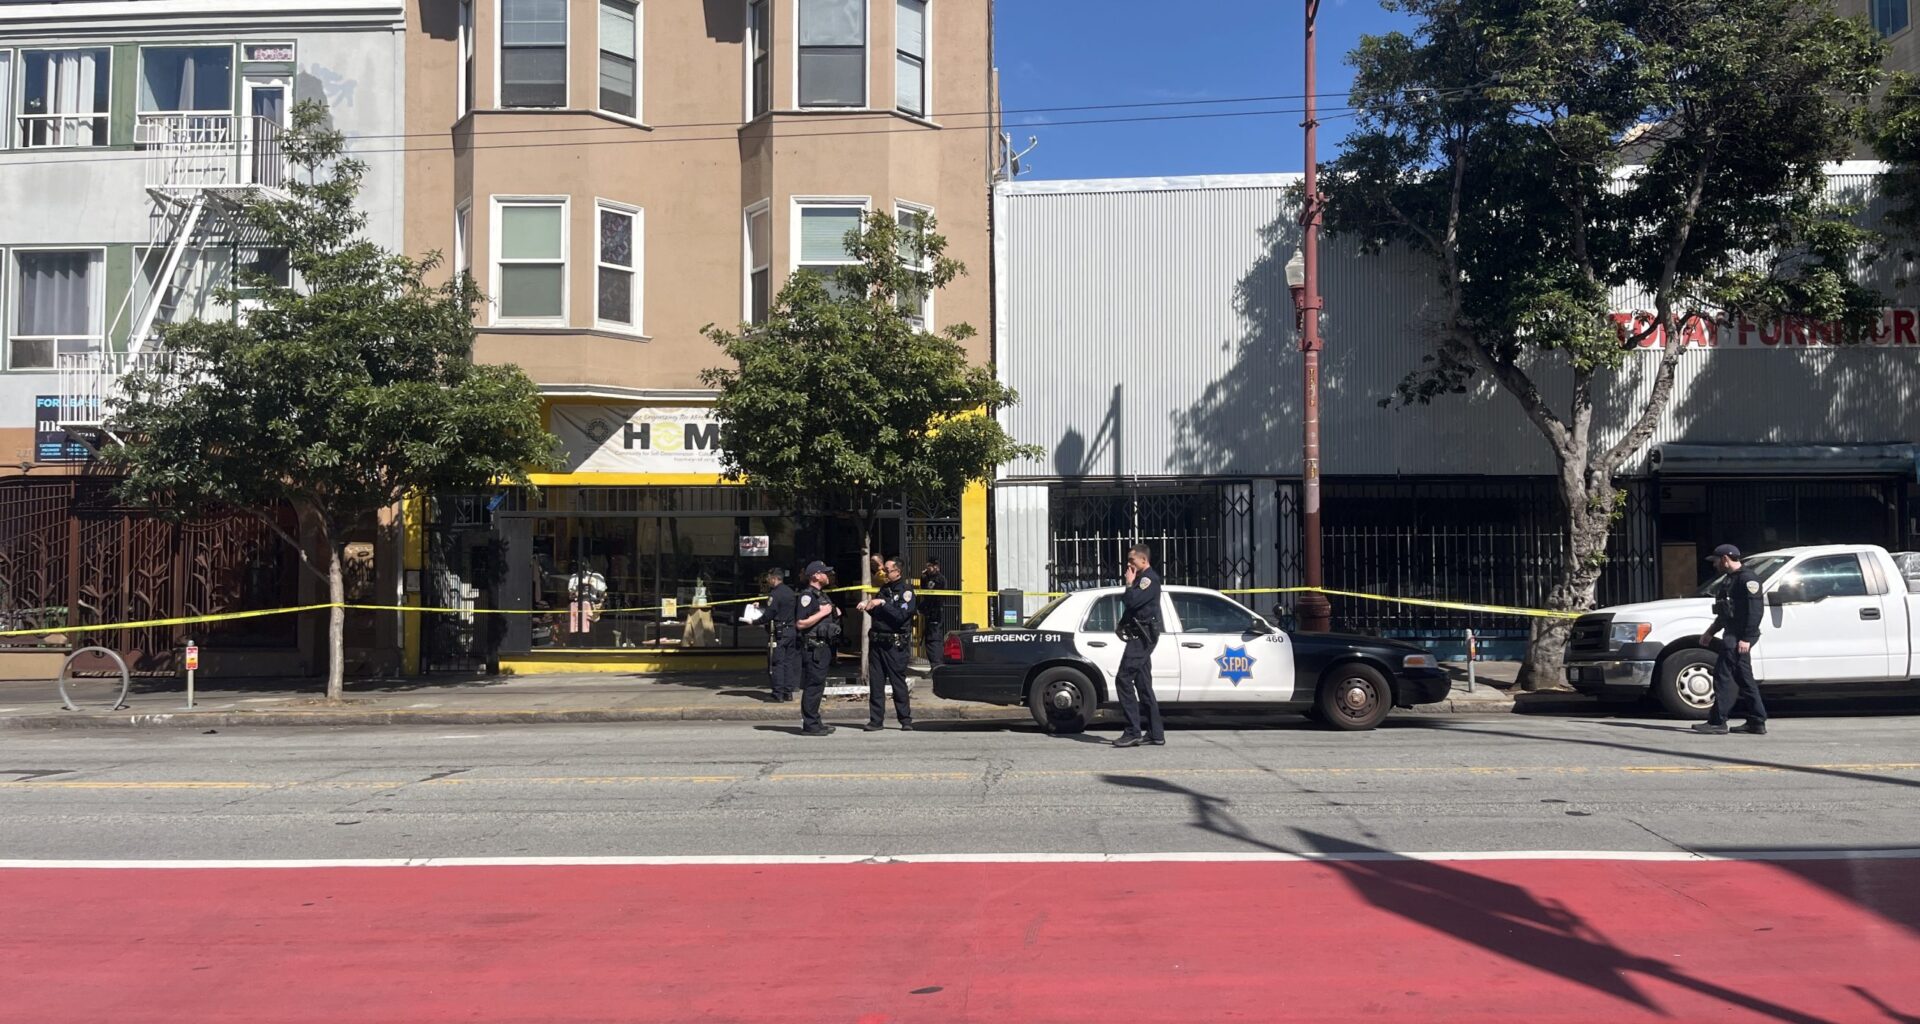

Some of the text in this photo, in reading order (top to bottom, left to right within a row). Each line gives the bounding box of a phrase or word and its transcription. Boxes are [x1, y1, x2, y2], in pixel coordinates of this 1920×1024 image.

[37, 398, 60, 408] FOR
[624, 422, 720, 450] HOM
[972, 633, 1037, 643] EMERGENCY
[1044, 633, 1061, 642] 911
[1265, 635, 1284, 643] 460
